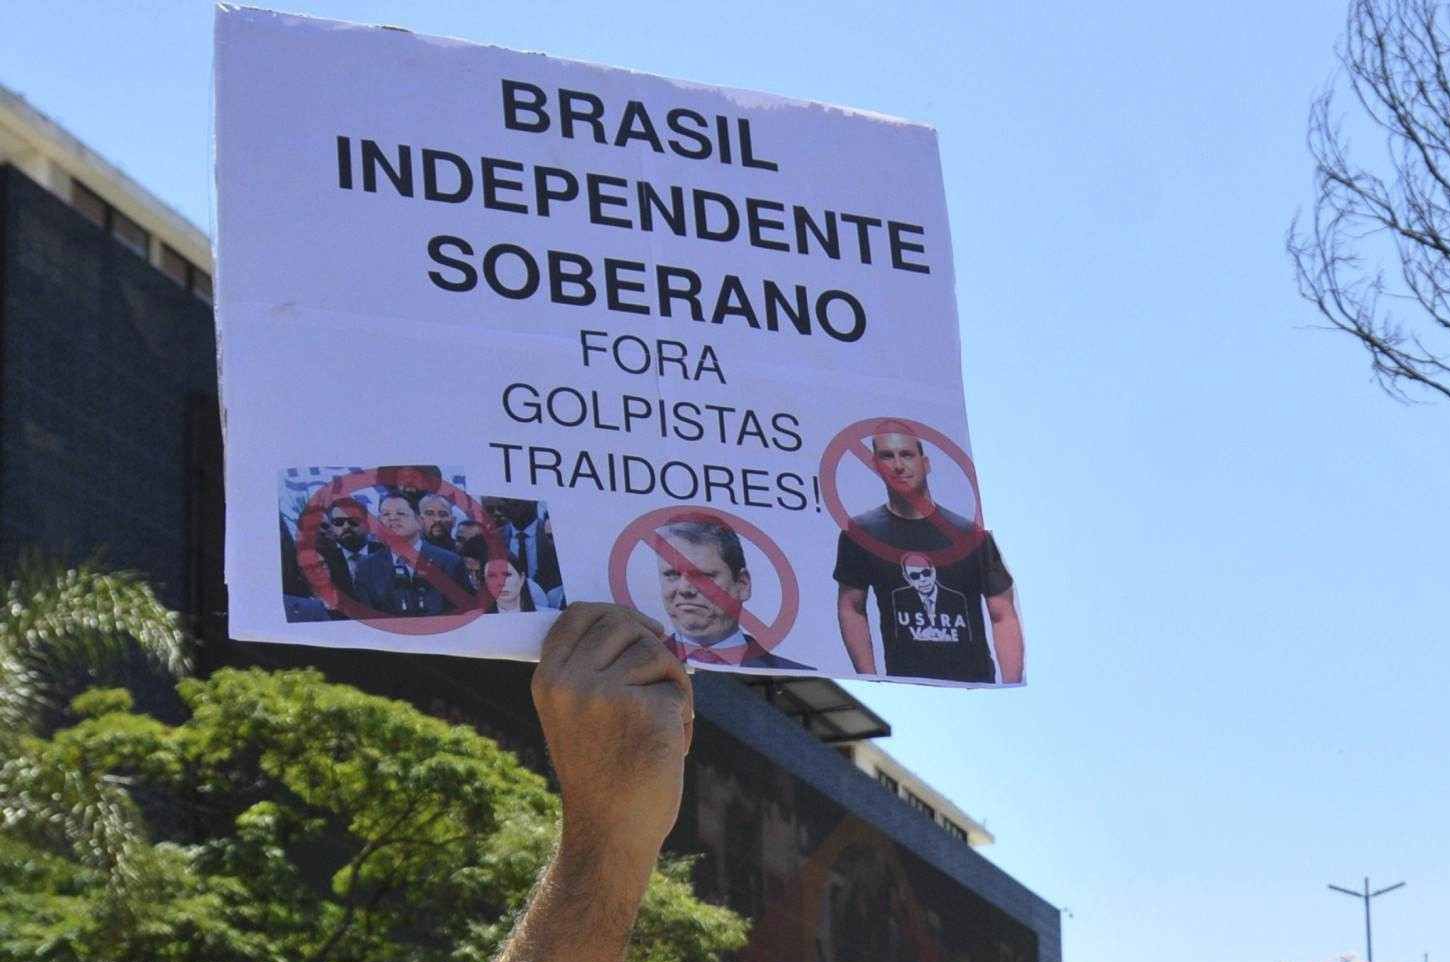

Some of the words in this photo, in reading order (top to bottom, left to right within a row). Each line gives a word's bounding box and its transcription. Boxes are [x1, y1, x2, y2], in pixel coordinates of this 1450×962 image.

[501, 78, 779, 172] BRASIL
[336, 135, 932, 275] INDEPENDENTE
[427, 235, 867, 344] SOBERANO
[580, 329, 727, 385] FORA
[502, 382, 803, 452] GOLPISTAS
[489, 442, 823, 513] TRAIDORES!
[898, 611, 966, 627] USTRA
